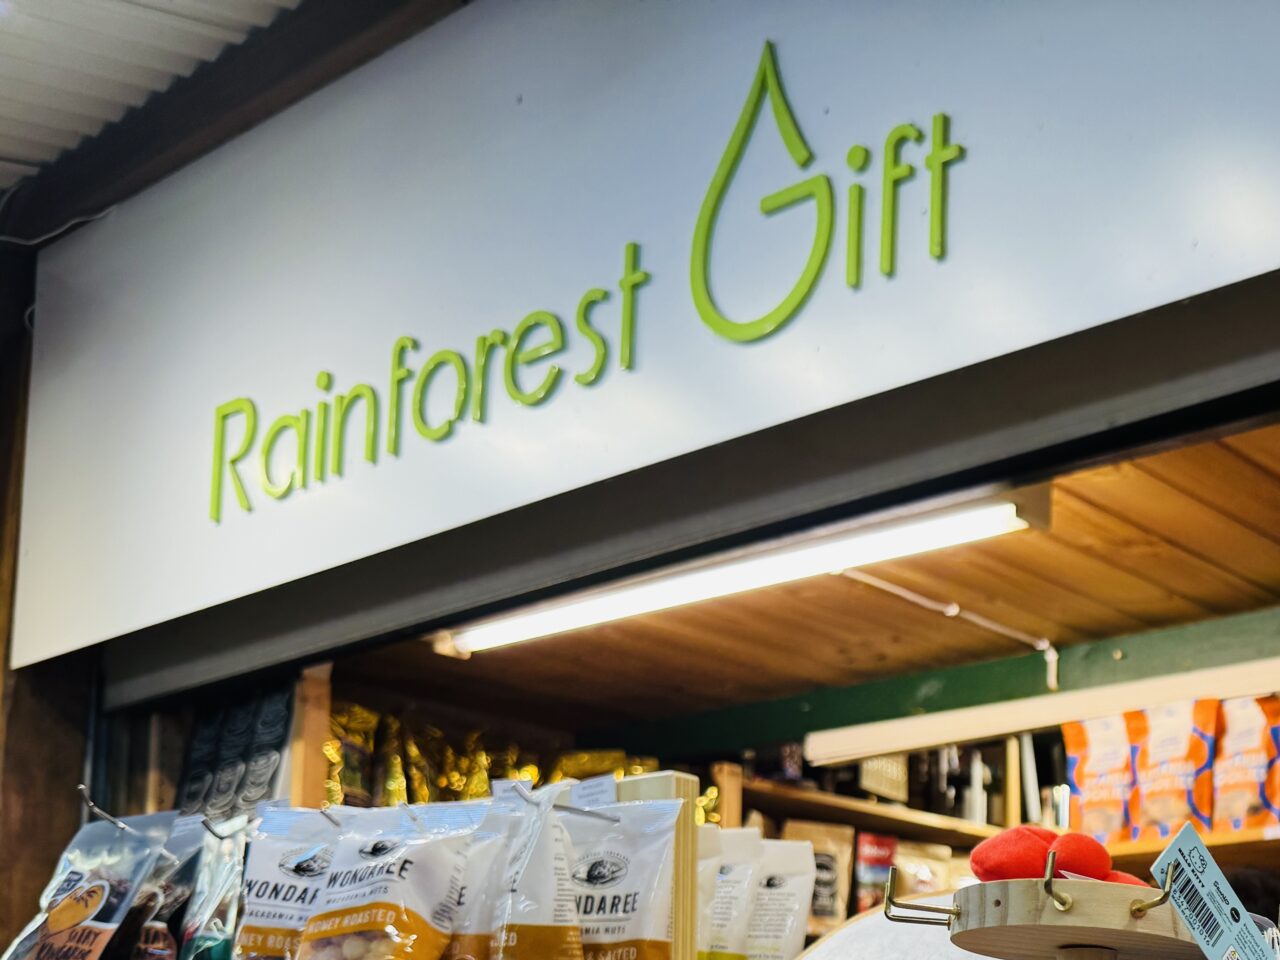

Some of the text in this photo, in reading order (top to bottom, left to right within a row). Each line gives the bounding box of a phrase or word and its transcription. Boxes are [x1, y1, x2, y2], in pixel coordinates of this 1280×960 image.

[210, 40, 968, 523] Rainforest Gift
[327, 859, 414, 889] WONDAREE
[1177, 847, 1206, 888] HELLO KITTY
[343, 909, 396, 927] ROASTED
[575, 892, 640, 915] NDAREE
